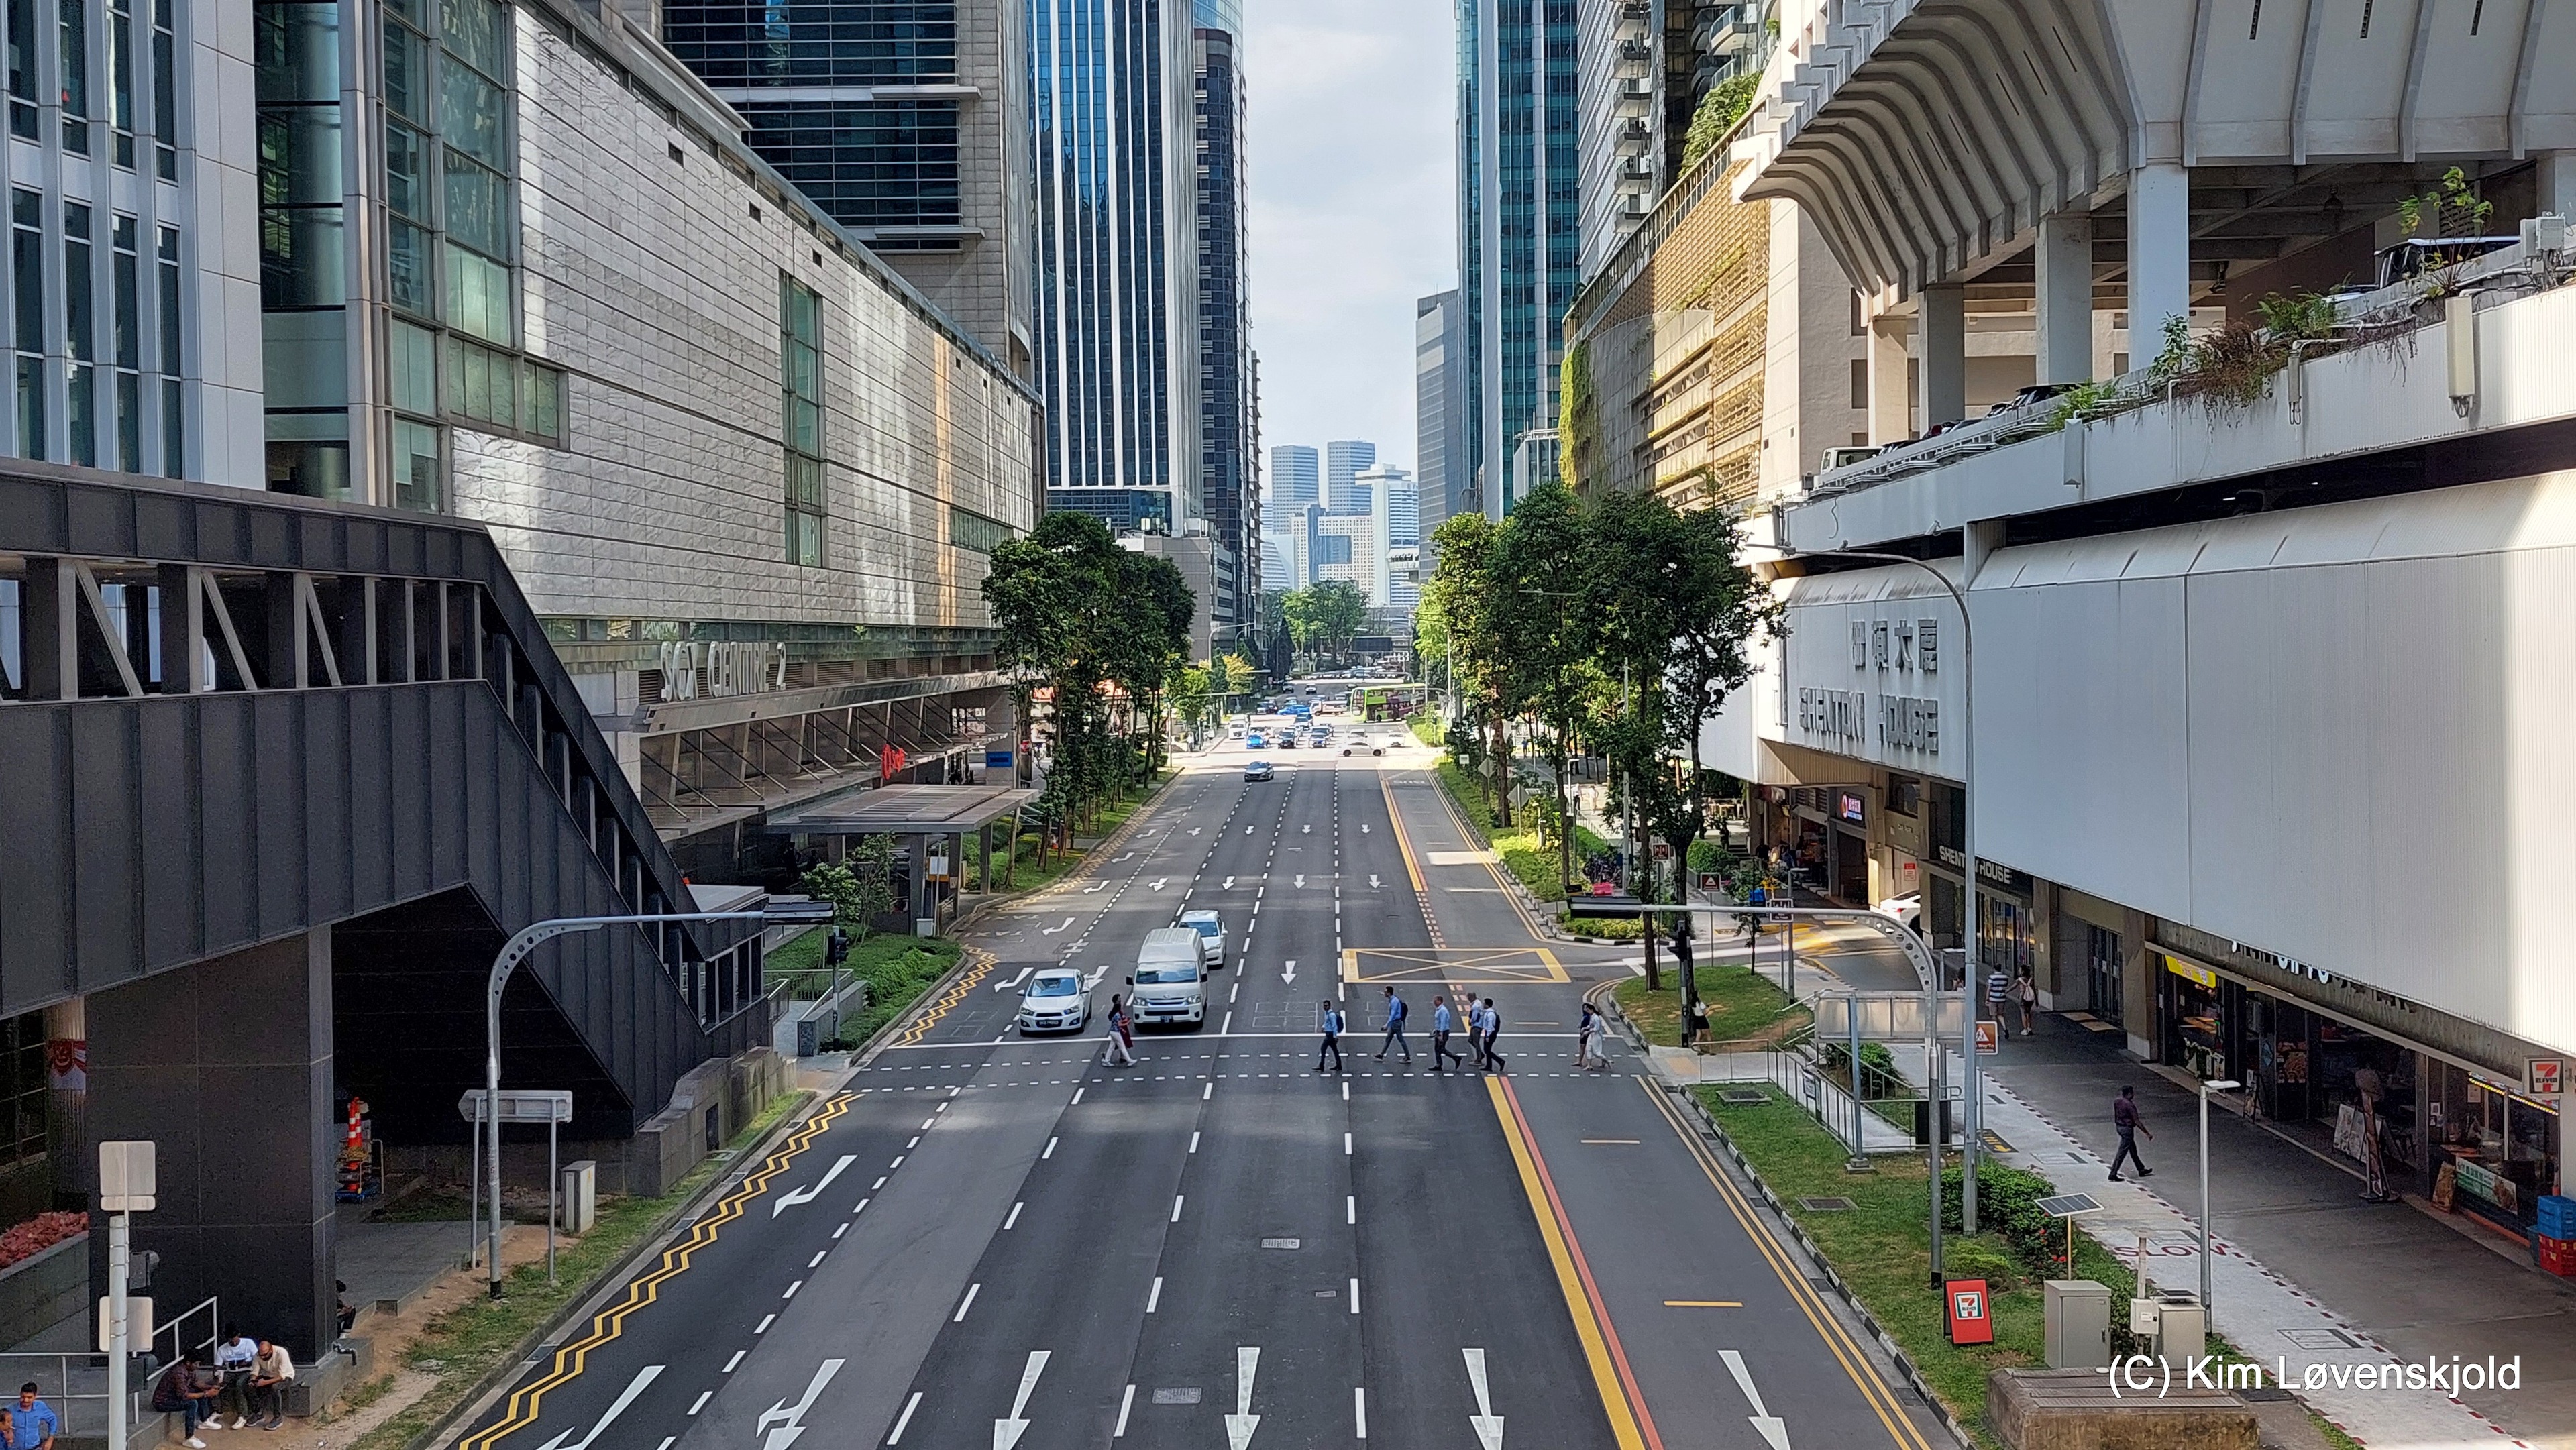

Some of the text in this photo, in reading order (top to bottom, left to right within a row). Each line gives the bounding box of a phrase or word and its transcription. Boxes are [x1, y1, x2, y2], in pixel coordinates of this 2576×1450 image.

[661, 641, 786, 702] SGX CENTRE 2
[1799, 687, 1938, 754] SHENTON HOUSE
[1980, 860, 2011, 884] HOUSE
